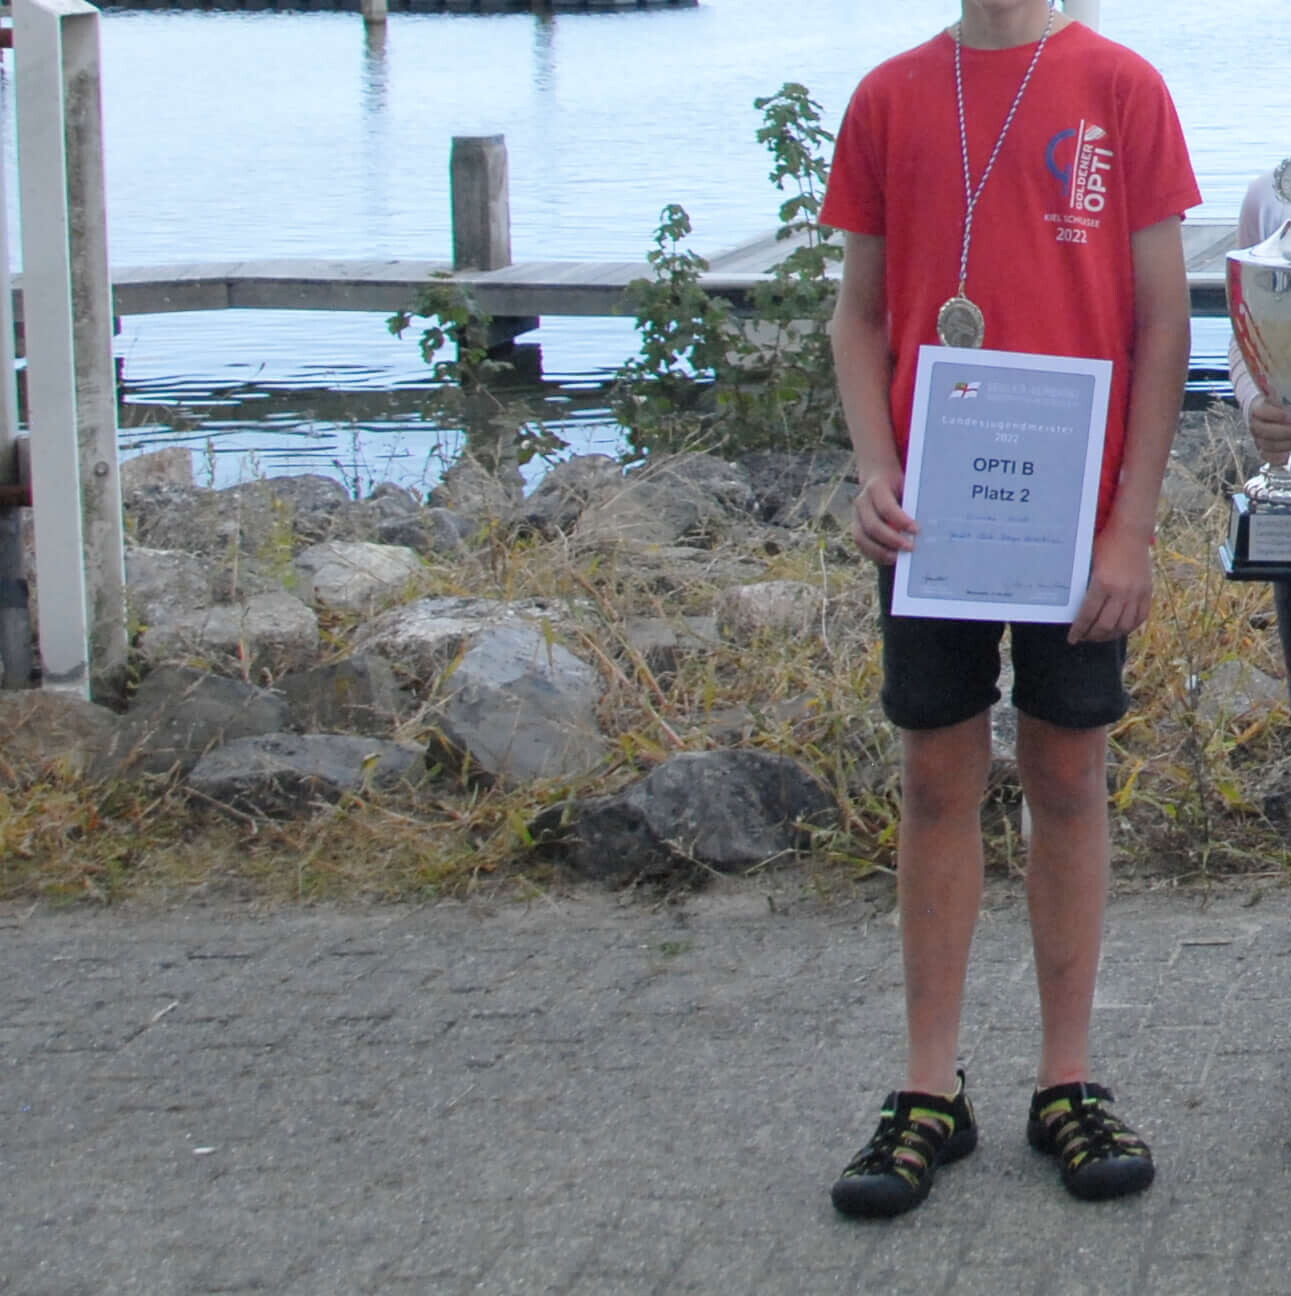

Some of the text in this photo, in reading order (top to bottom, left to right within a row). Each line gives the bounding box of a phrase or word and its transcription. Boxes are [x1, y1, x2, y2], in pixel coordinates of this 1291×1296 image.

[1075, 144, 1095, 211] GOLDENER
[1083, 147, 1114, 213] OPTI
[1056, 227, 1088, 244] 2022
[972, 457, 1035, 476] OPTI B
[971, 485, 1031, 503] Platz 2
